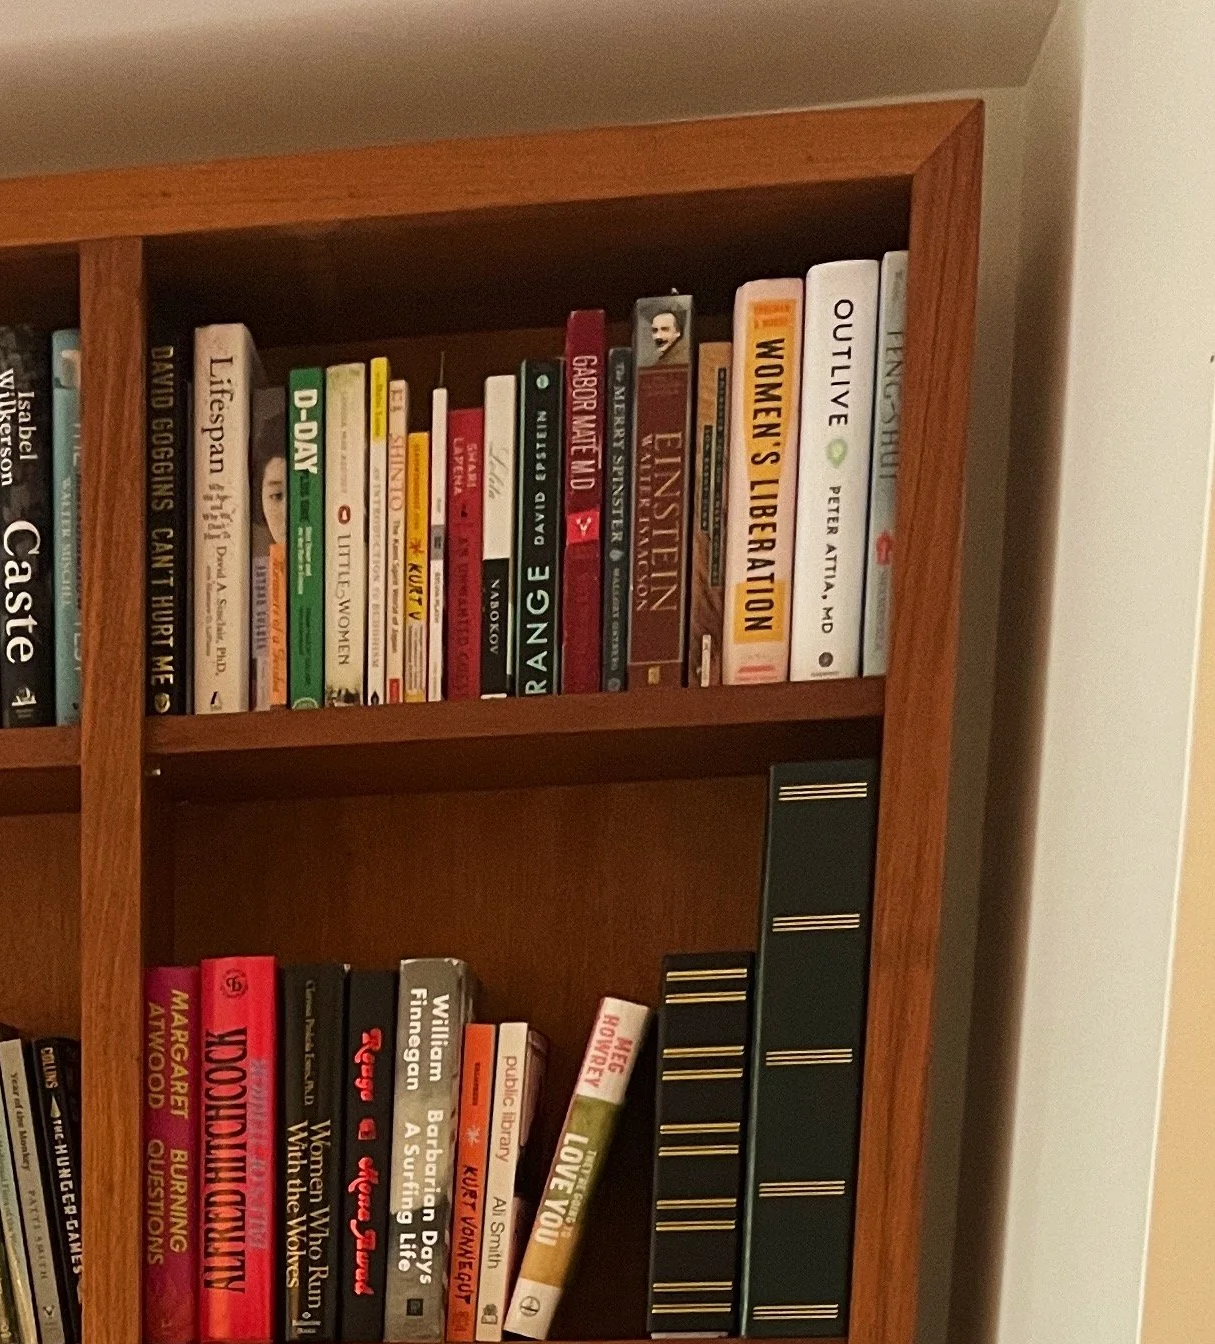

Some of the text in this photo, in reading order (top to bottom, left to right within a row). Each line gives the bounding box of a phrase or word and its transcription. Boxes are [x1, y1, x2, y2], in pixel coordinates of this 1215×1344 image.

[17, 391, 38, 461] Isabel
[201, 356, 234, 474] Lifespan
[293, 389, 317, 474] D-DAY
[750, 337, 785, 465] WOMEN'S
[820, 300, 855, 634] OUTLIVE PETER ATTIA, MD
[150, 346, 174, 684] DAVID GOGGINS CAN'T HURT ME
[408, 562, 423, 602] KURT
[525, 410, 550, 696] RANGE DAVID EPSTEIN
[636, 433, 653, 612] WALTER ISAACSON
[650, 433, 683, 612] EINSTEIN
[744, 479, 781, 632] LIBERATION
[3, 520, 40, 664] Caste
[335, 532, 351, 666] LITTLE WOMEN
[489, 578, 501, 654] NABOKOV
[169, 989, 189, 1253] MARGARET BURNING
[584, 1014, 619, 1088] HOWREY
[608, 1038, 634, 1073] MEG
[146, 1002, 165, 1265] ATWOOD QUESTIONS
[286, 1119, 308, 1288] With the Wolves
[396, 988, 427, 1272] Finnegan A Surfing Life
[416, 994, 449, 1284] William Barbarian Days
[487, 1055, 520, 1269] public library Ali Smith
[534, 1132, 588, 1246] LOVE YOU
[308, 1119, 331, 1309] Women Who Run
[456, 1165, 478, 1305] KURT VONNEGUT
